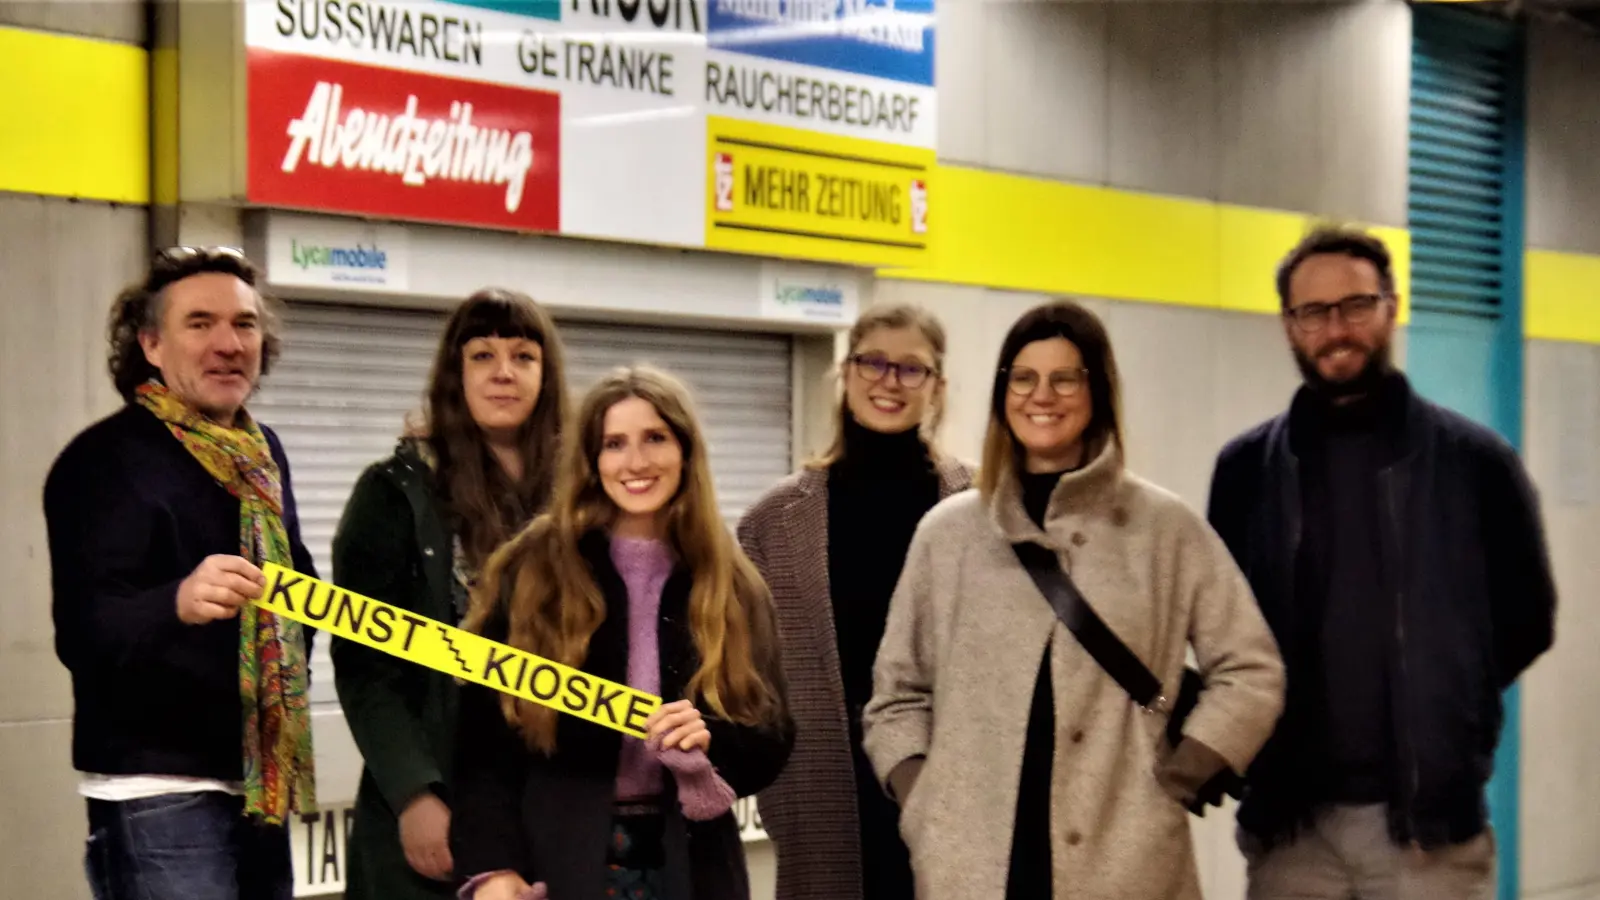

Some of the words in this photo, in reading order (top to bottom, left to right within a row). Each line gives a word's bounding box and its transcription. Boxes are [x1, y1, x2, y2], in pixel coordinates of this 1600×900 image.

[281, 81, 532, 213] Abendzeitung
[705, 61, 919, 132] RAUCHERBEDARF
[744, 164, 810, 213] MEHR
[816, 173, 901, 225] ZEITUNG
[268, 570, 427, 653] KUNST
[482, 646, 654, 733] KIOSKE
